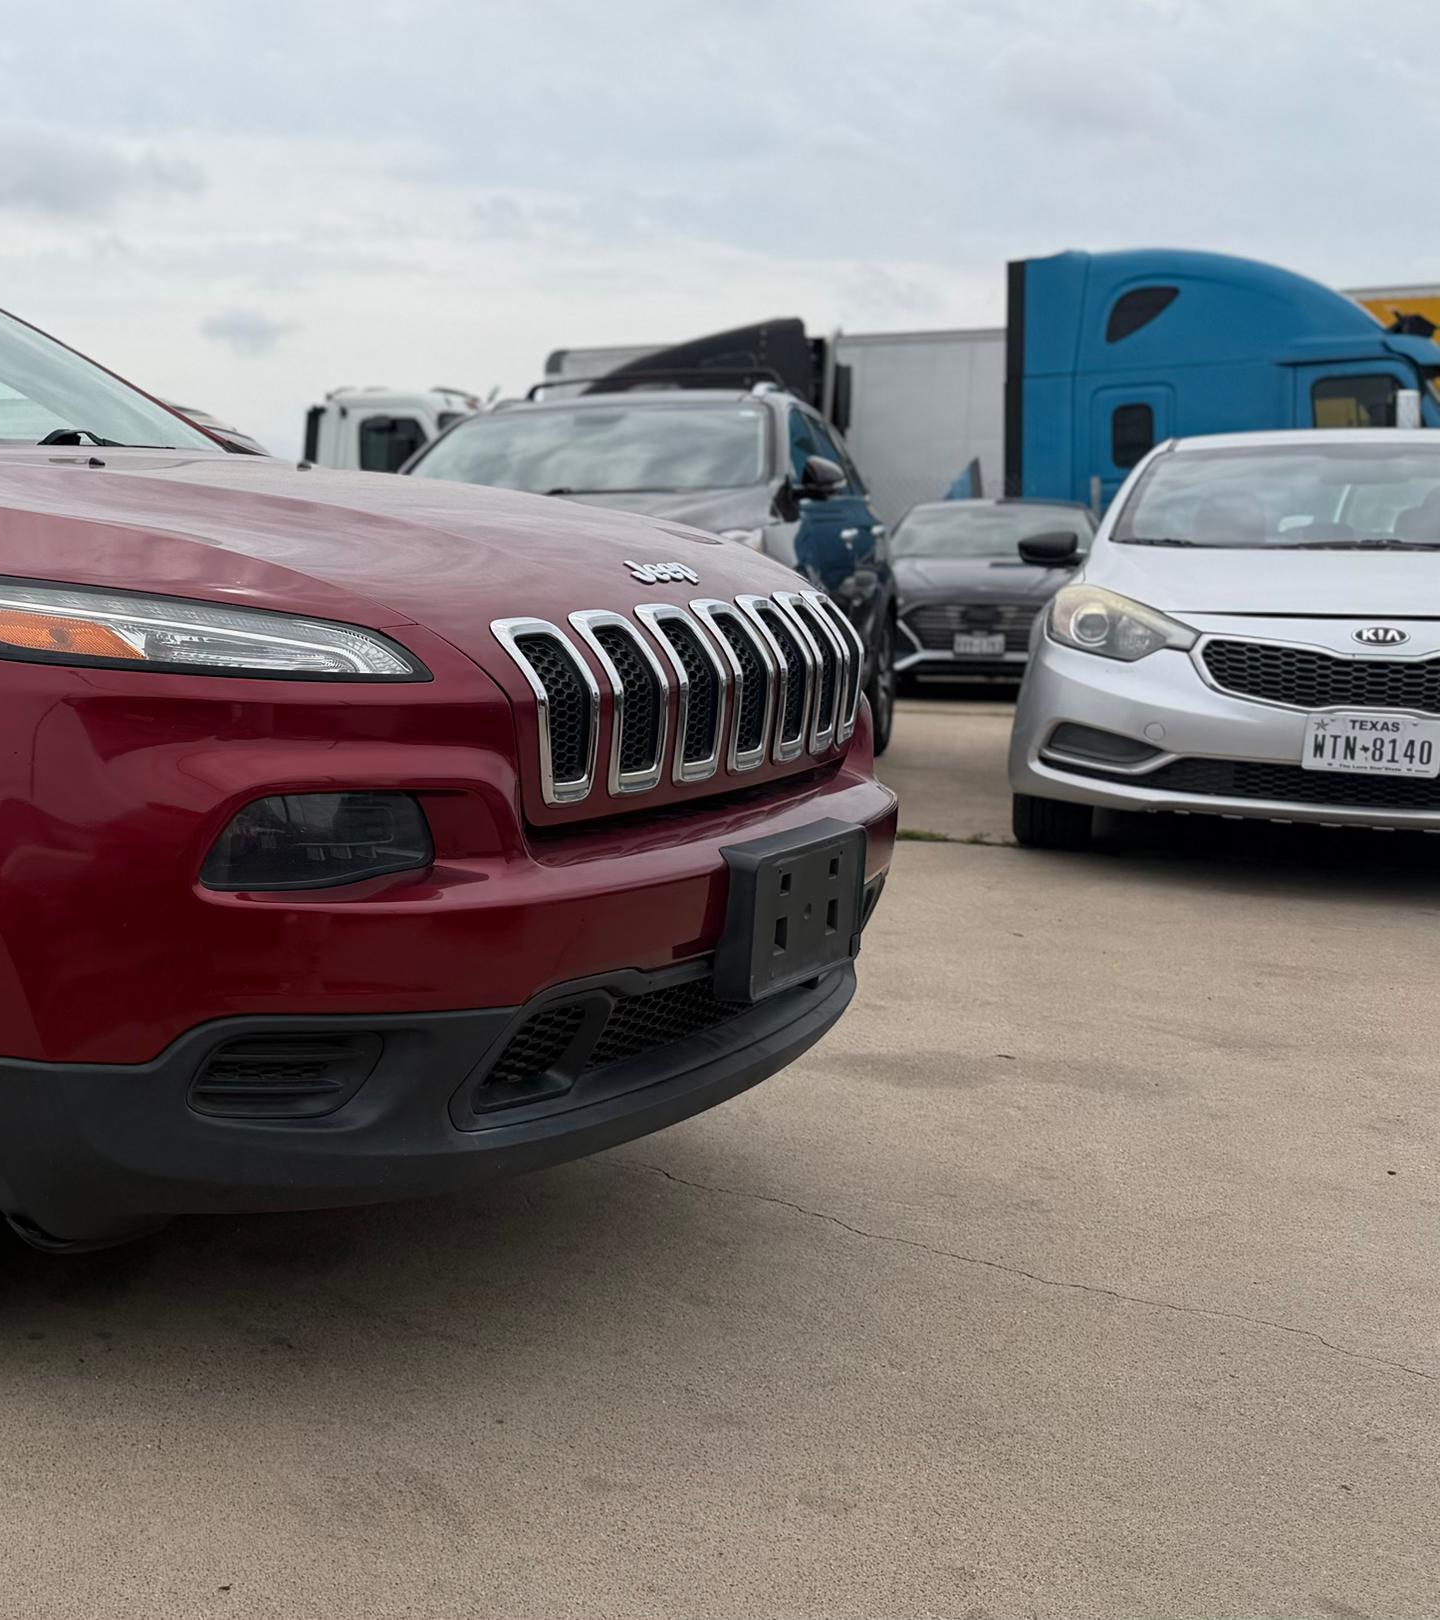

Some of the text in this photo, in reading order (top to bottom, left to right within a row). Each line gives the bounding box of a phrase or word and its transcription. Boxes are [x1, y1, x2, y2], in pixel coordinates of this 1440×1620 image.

[623, 560, 699, 585] Jeep
[1362, 628, 1401, 641] KIA
[1349, 719, 1400, 733] TEXAS
[1313, 734, 1433, 765] WTN 8140
